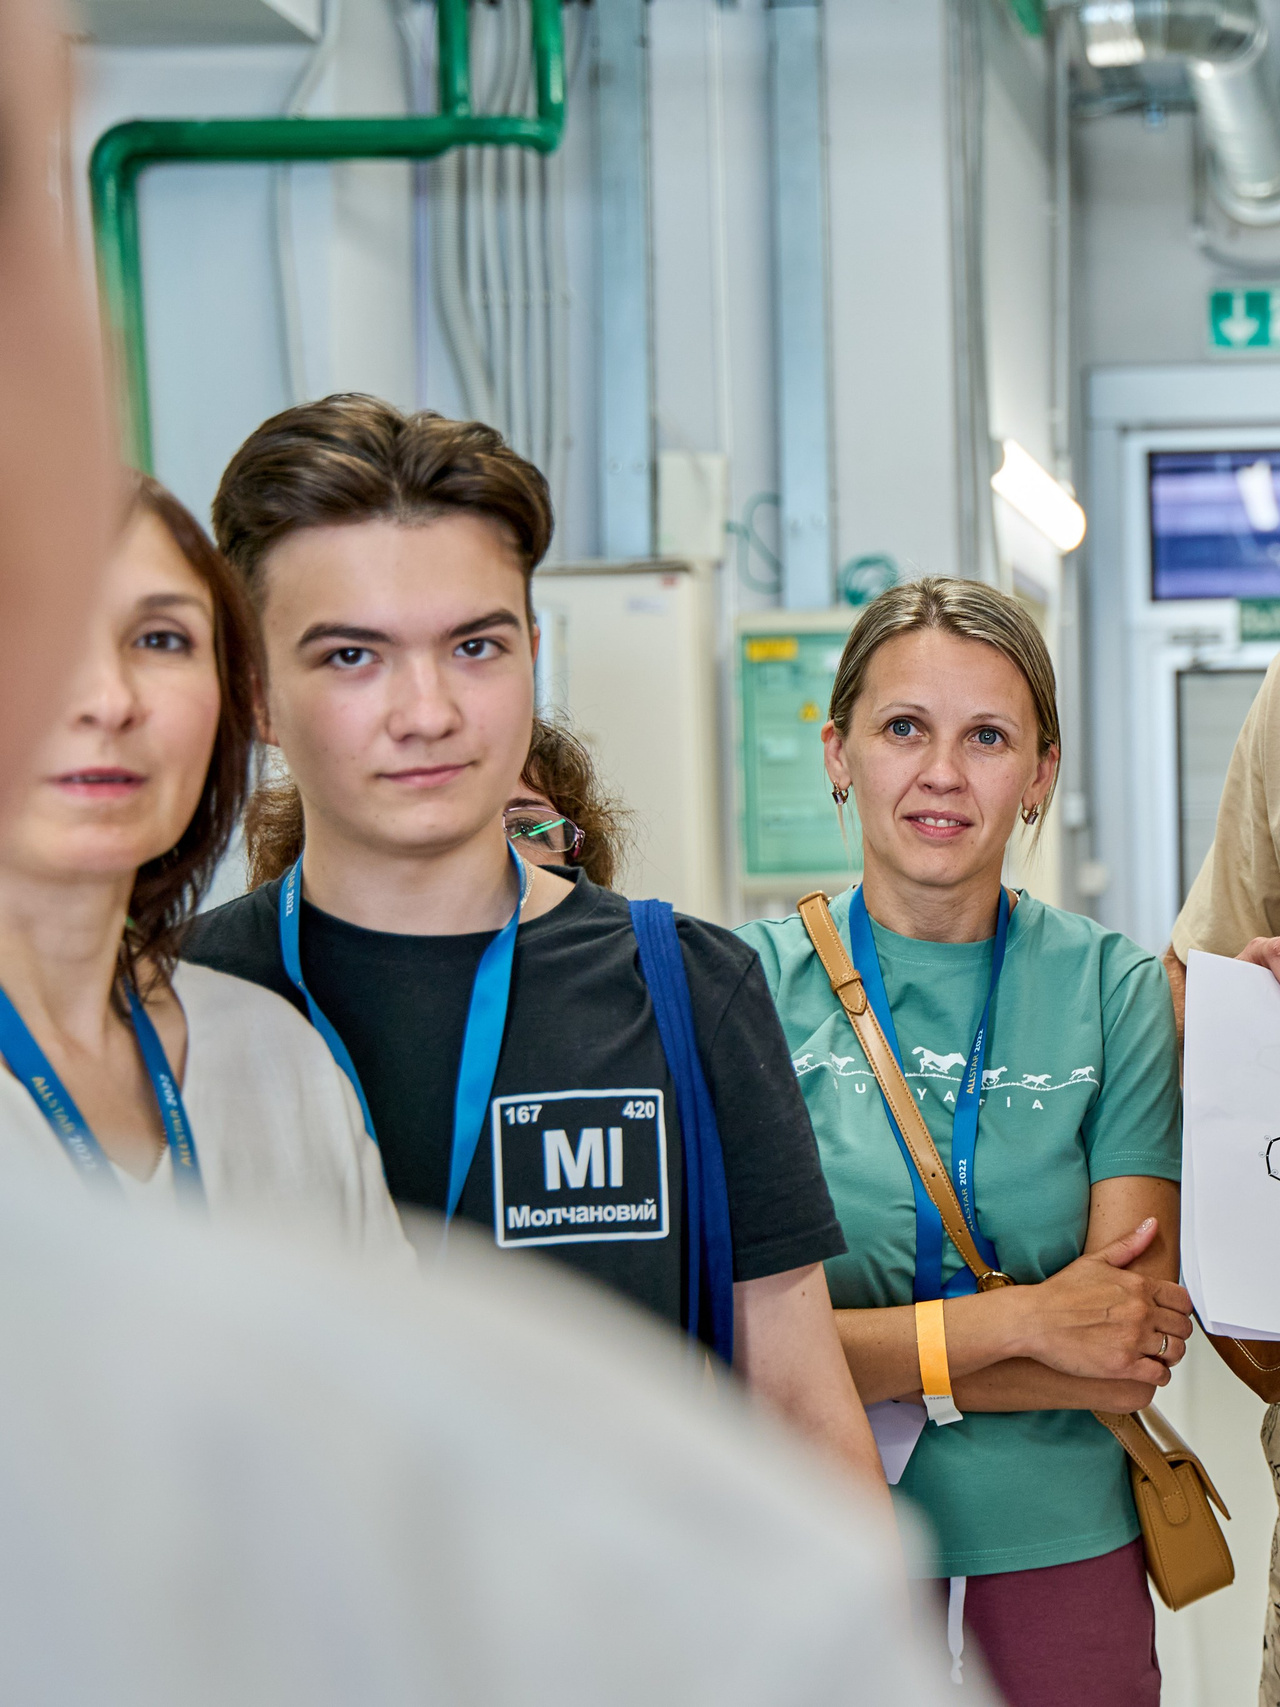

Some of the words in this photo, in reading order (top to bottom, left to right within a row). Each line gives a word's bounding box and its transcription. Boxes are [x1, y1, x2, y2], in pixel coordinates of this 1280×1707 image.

[285, 889, 295, 917] 2022
[966, 1053, 979, 1095] ALLSTAR
[974, 1028, 984, 1053] 2022
[159, 1073, 177, 1107] 2022
[31, 1075, 76, 1134] ALLSTAR
[68, 1134, 97, 1171] 2022
[504, 1104, 543, 1125] 167
[622, 1101, 656, 1119] 420
[958, 1158, 967, 1186] 2022
[507, 1198, 657, 1229] Молчановий
[961, 1188, 975, 1232] ALLSTAR
